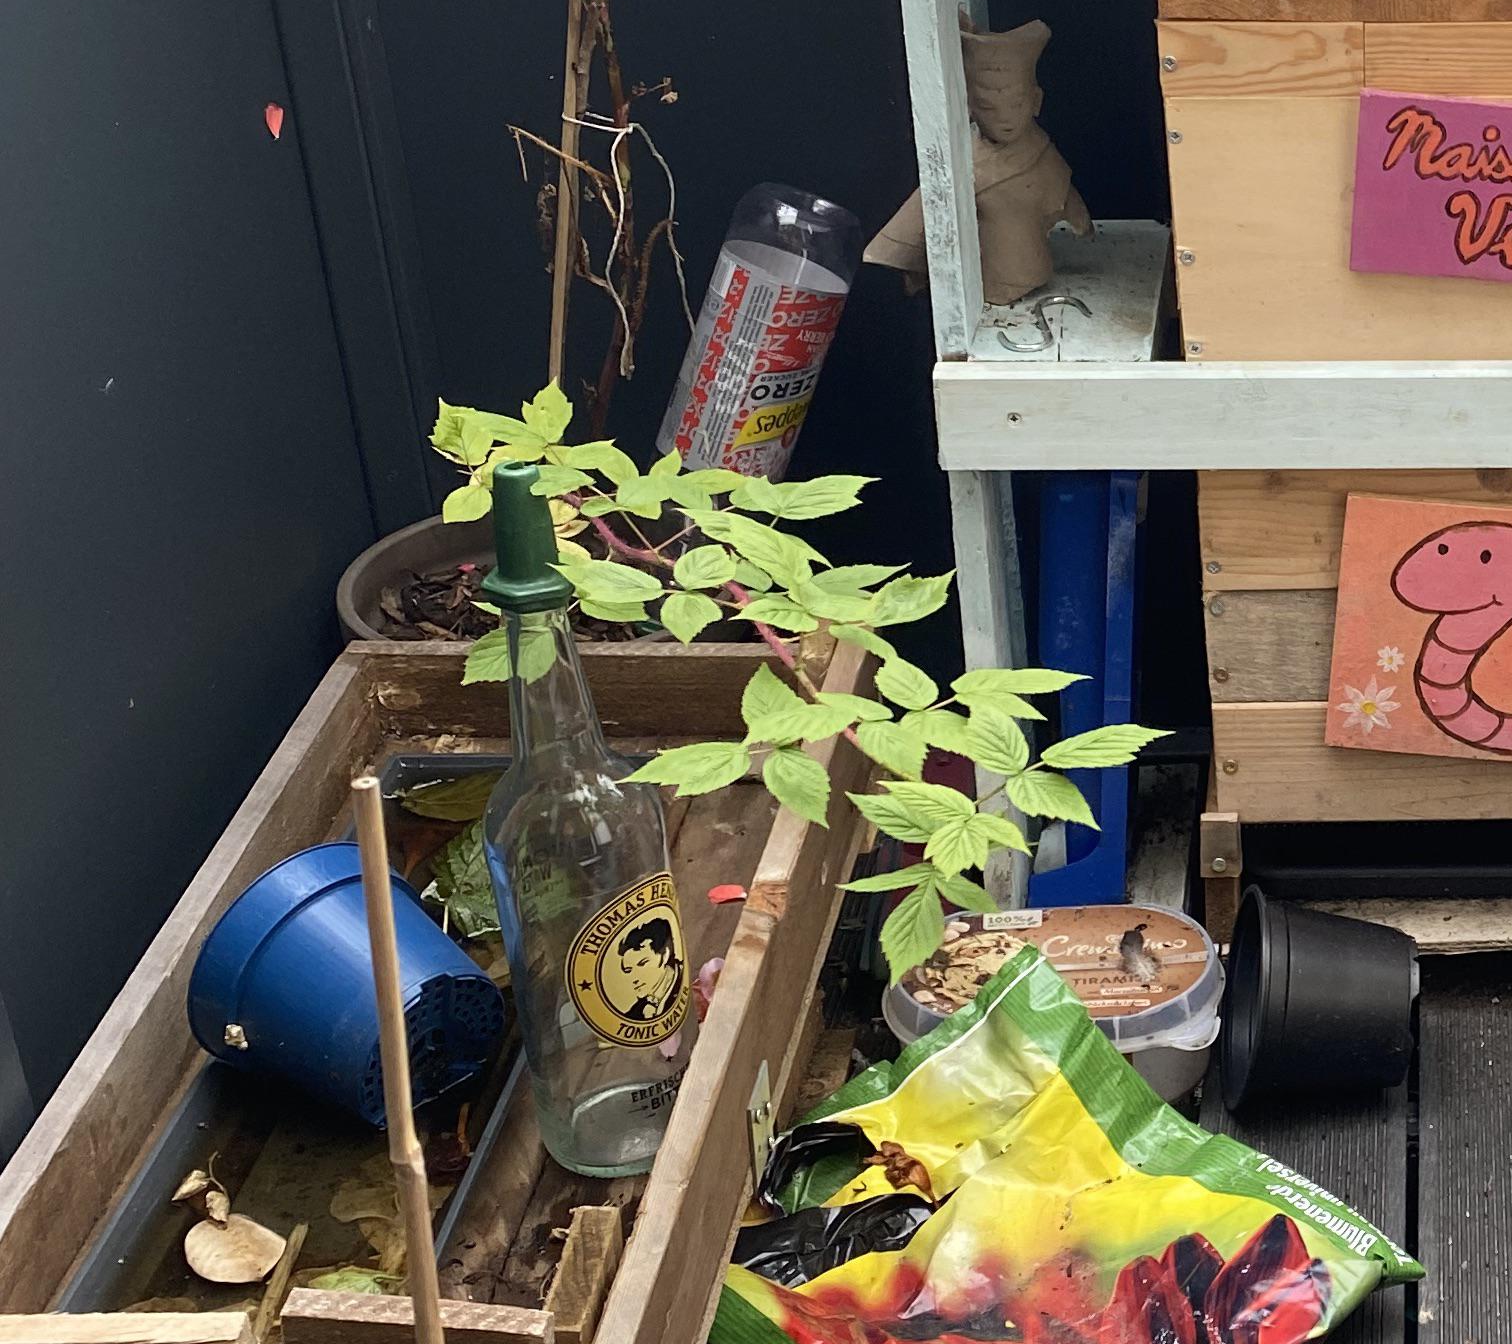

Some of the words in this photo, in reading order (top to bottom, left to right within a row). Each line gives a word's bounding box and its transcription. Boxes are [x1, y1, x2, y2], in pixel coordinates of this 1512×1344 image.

[749, 373, 816, 402] ZERO
[580, 891, 646, 957] THOMAS
[615, 1022, 661, 1040] TONIC
[663, 985, 690, 1032] WATER
